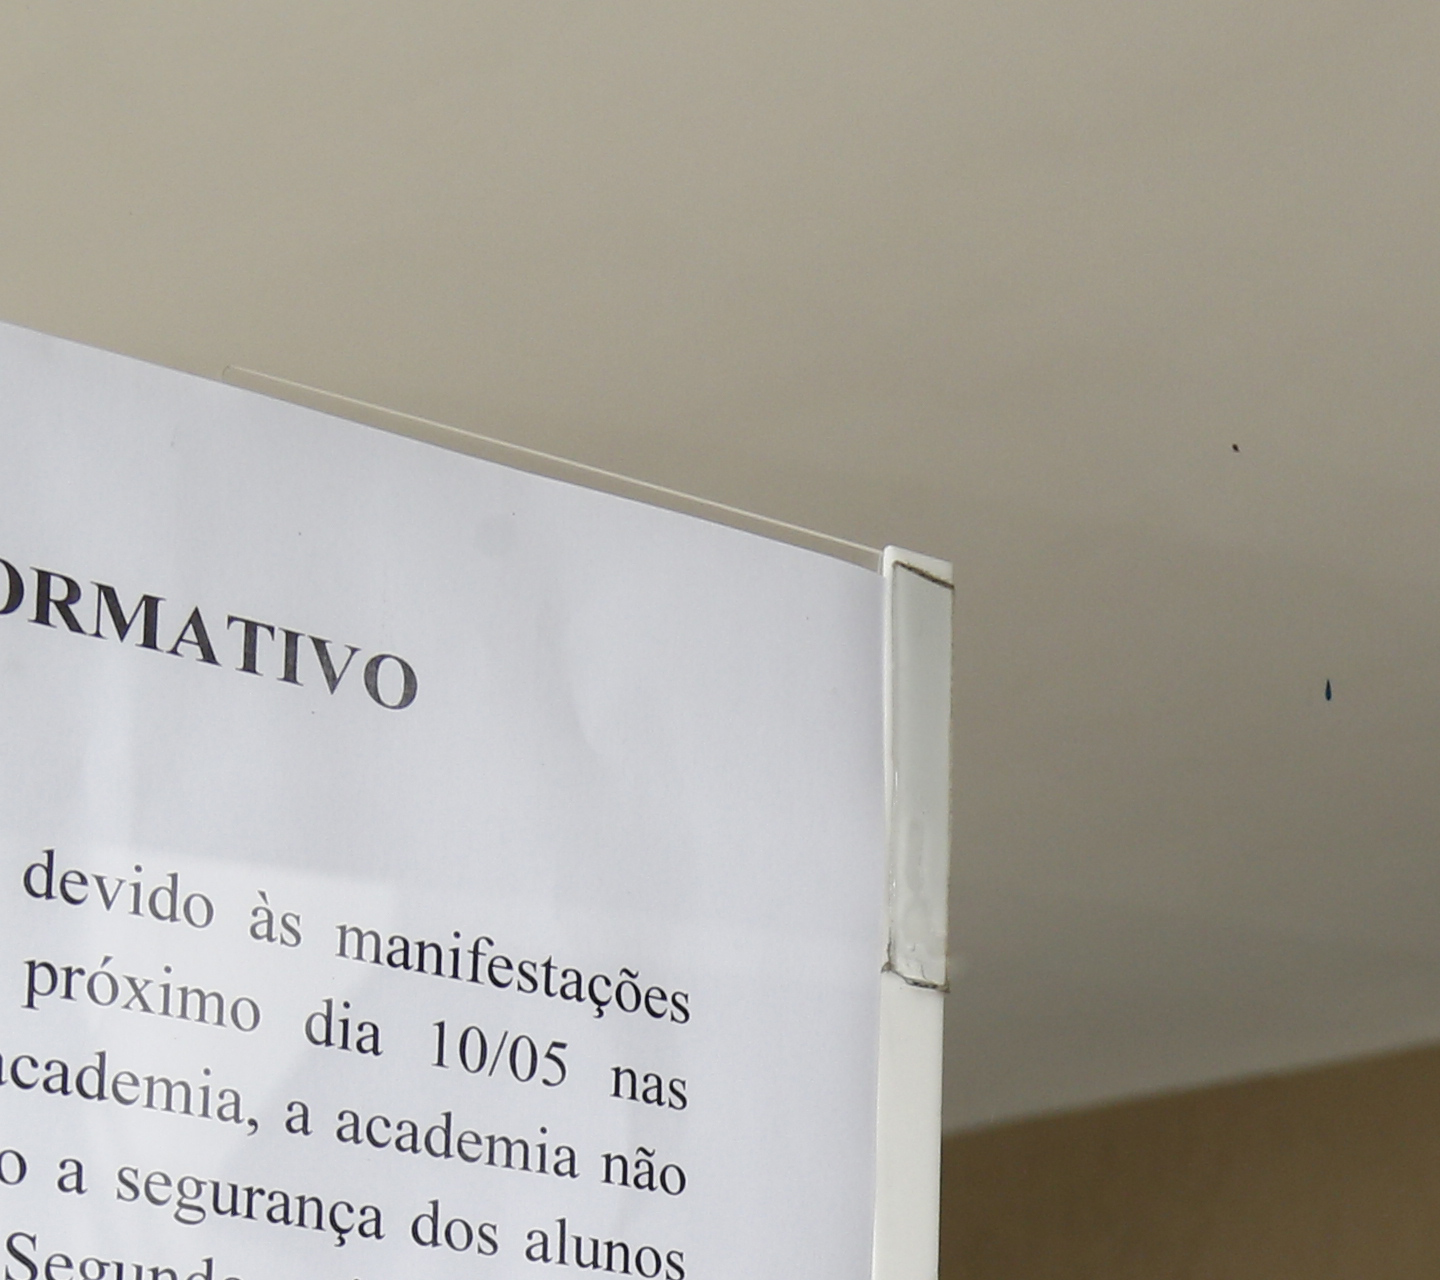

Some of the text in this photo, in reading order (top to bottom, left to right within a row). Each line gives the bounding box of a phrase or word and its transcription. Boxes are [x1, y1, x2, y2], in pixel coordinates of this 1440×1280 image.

[21, 846, 215, 930] devido
[247, 904, 303, 949] às
[334, 922, 692, 1026] manifestações
[19, 957, 262, 1033] próximo
[302, 996, 385, 1058] dia
[430, 1018, 569, 1089] 10/05
[608, 1064, 689, 1112] nas
[55, 1156, 89, 1196] a
[114, 1164, 387, 1249] segurança
[408, 1197, 500, 1257] dos
[282, 1098, 314, 1138] a
[333, 1107, 581, 1180] academia
[598, 1144, 688, 1197] não
